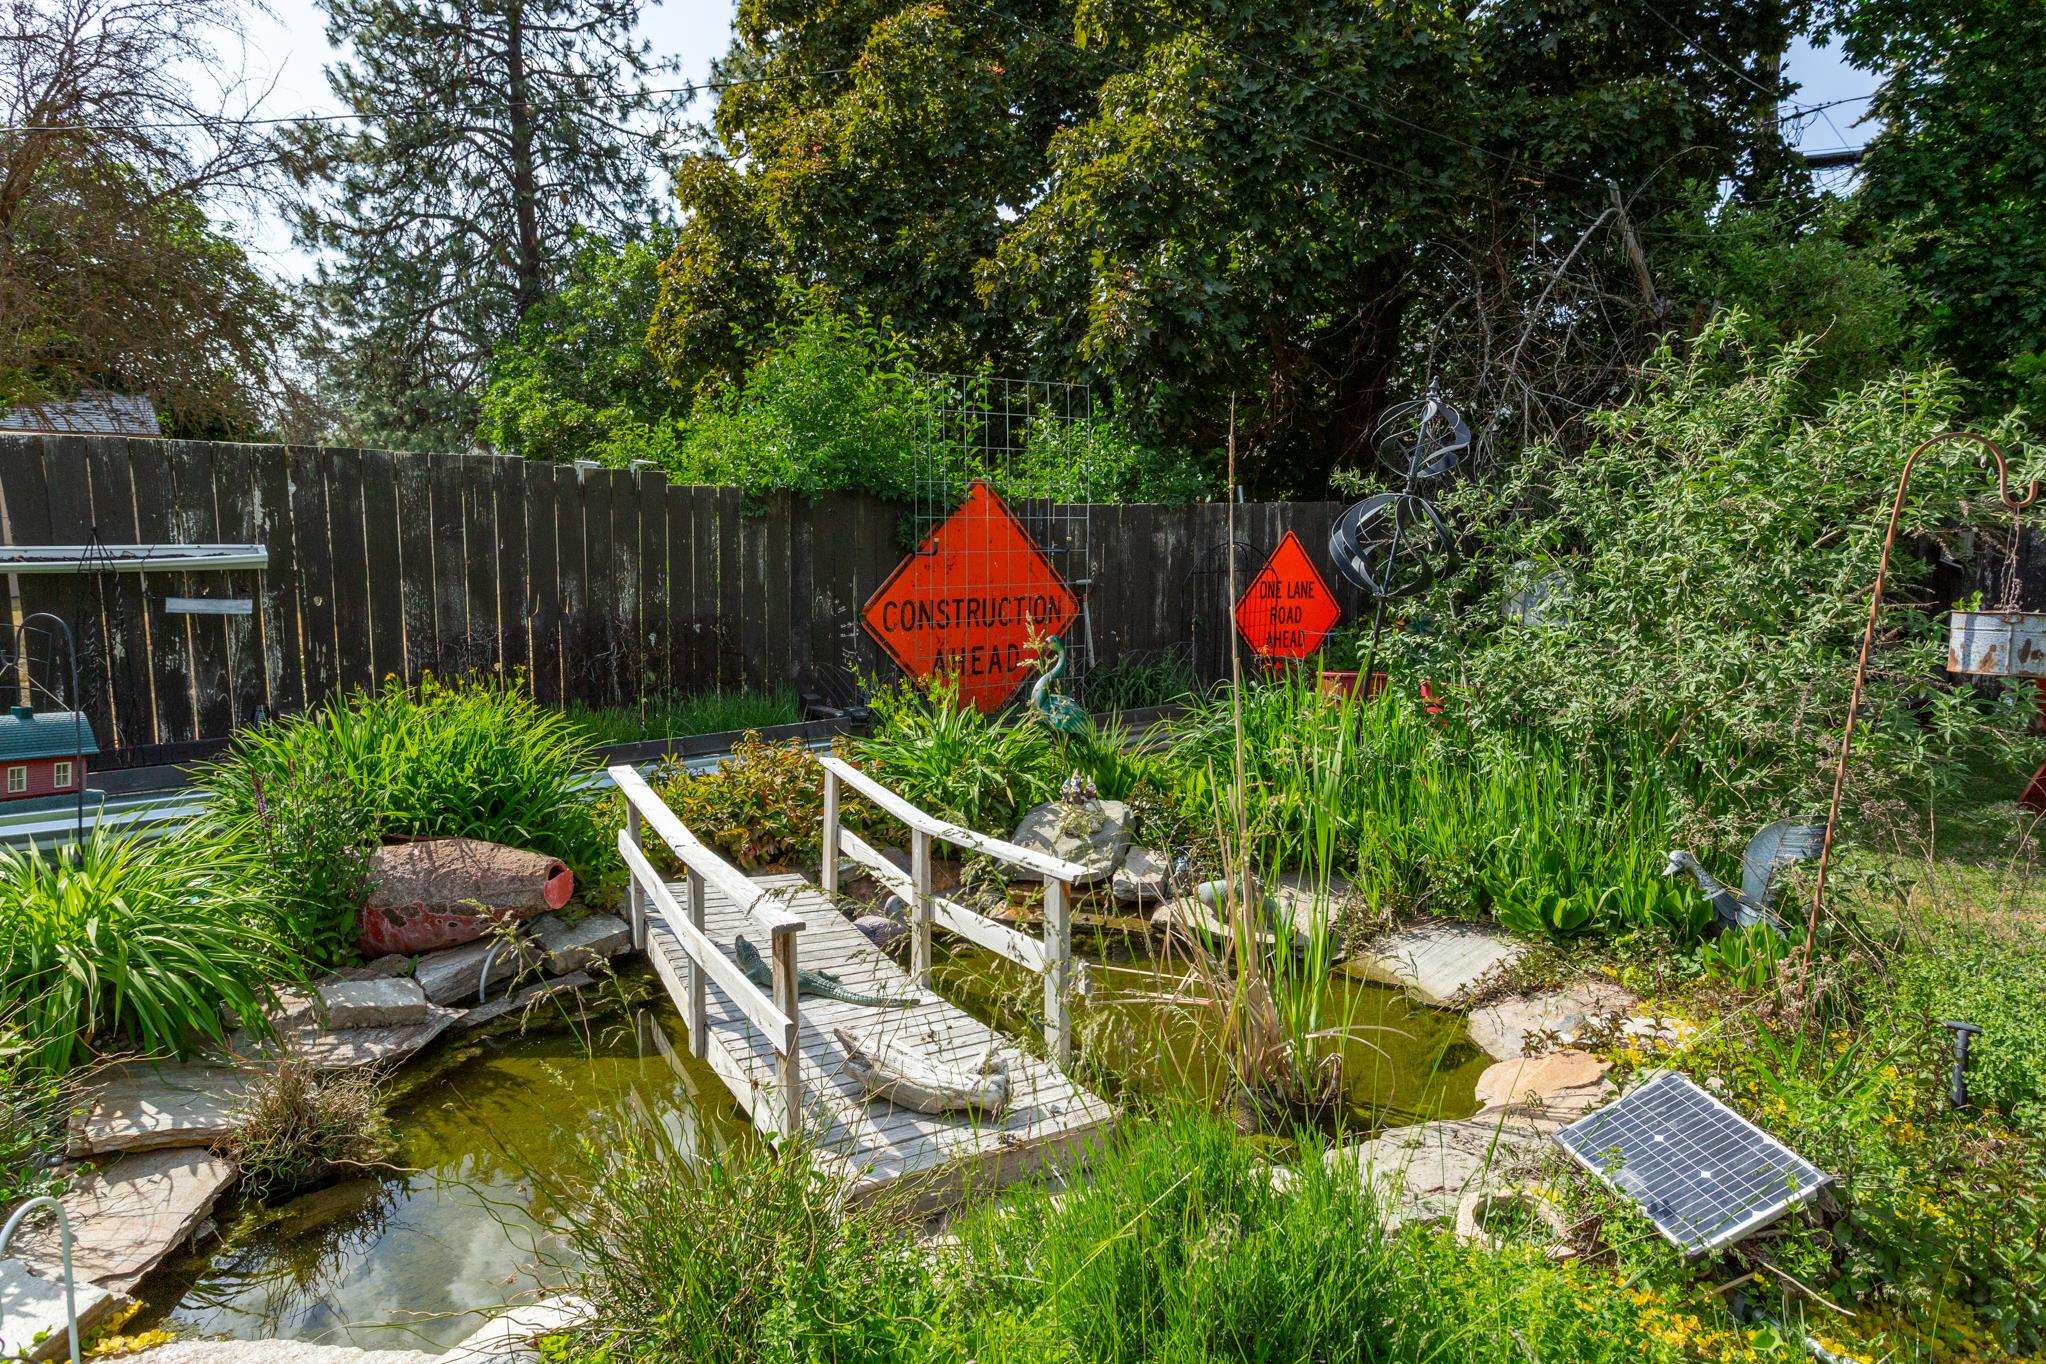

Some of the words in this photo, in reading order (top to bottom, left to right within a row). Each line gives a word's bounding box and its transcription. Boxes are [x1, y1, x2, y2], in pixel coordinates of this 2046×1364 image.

[1260, 581, 1282, 599] ONE
[1287, 581, 1315, 599] LANE
[882, 595, 1062, 633] CONSTRUCTION
[1270, 606, 1303, 624] ROAD
[1266, 631, 1305, 648] AHEAD
[932, 643, 1021, 677] AHEAD
